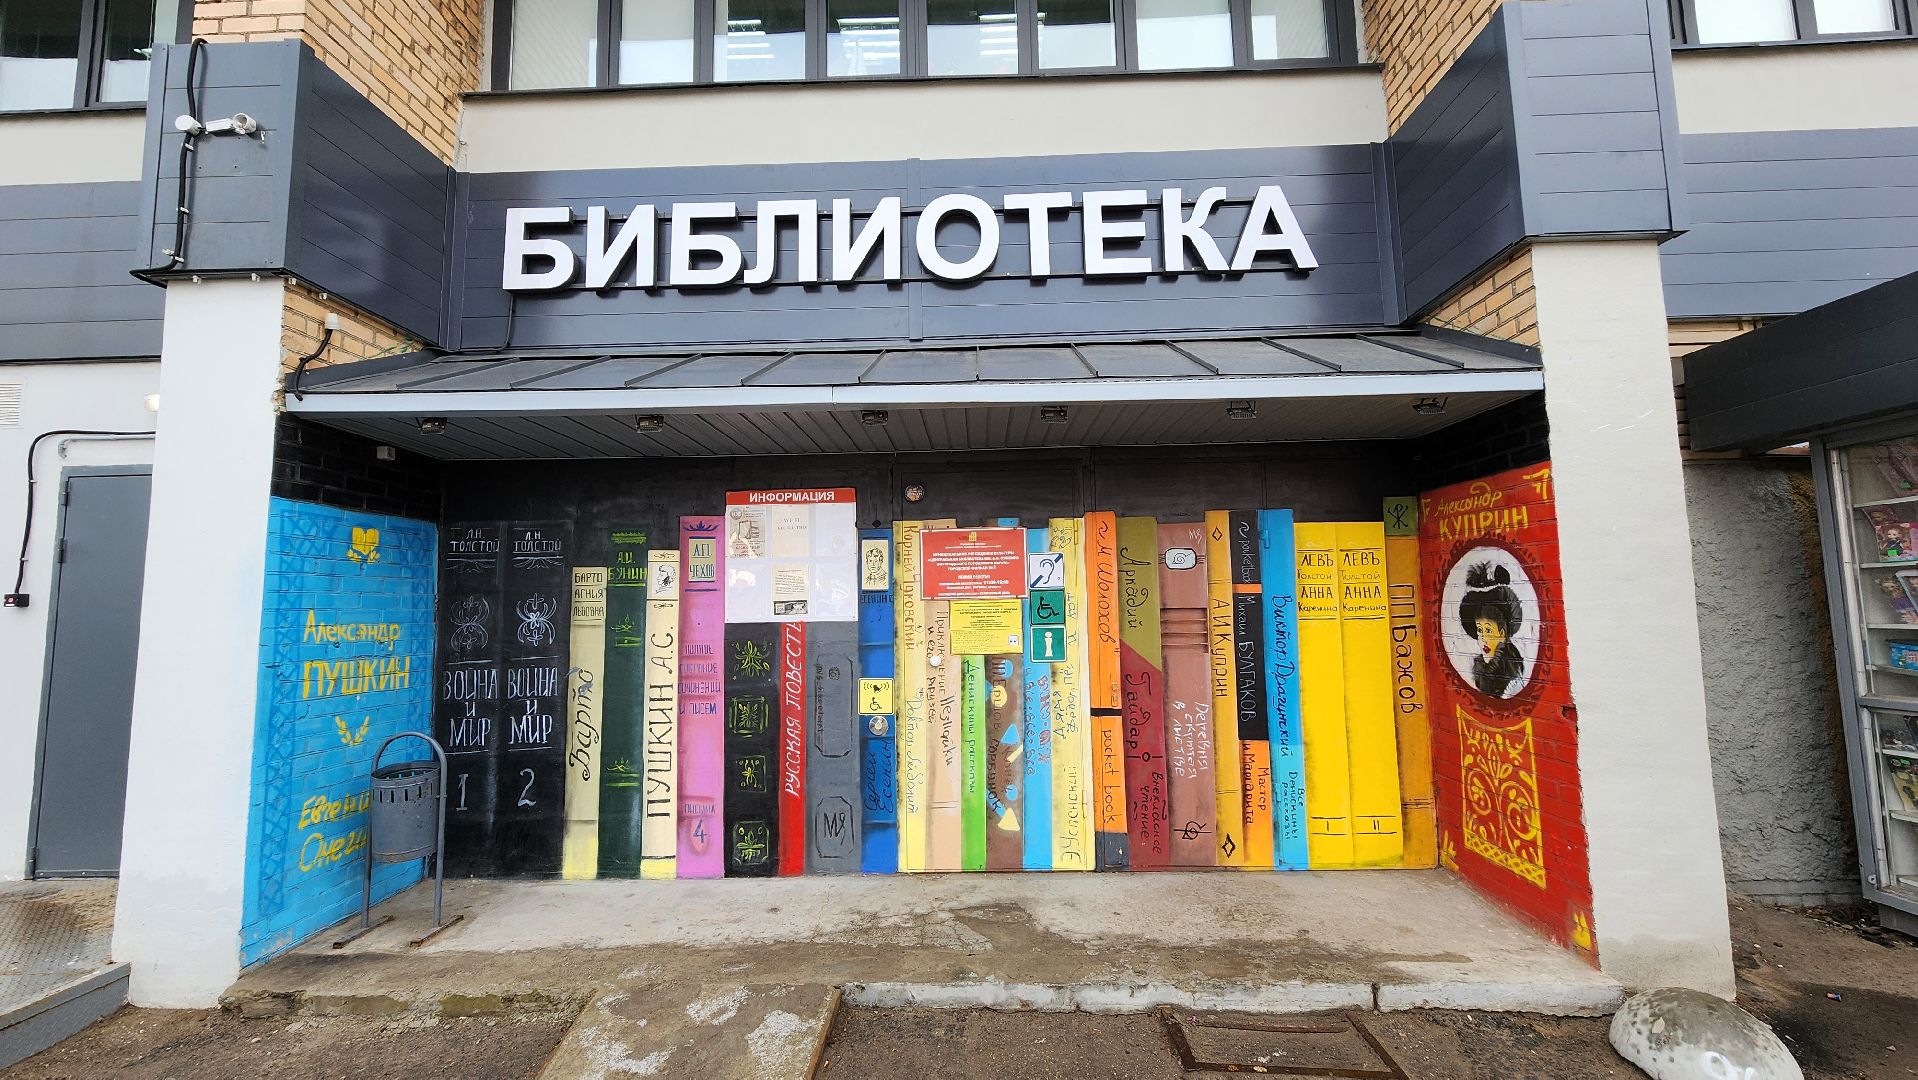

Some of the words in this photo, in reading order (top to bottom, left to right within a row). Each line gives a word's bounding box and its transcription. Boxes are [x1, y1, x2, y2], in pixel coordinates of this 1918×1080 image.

[503, 185, 1318, 290] БИБЛИОТЕКА
[749, 491, 835, 503] ИНФОРМАЦИЯ
[1434, 482, 1502, 516] Александр
[1440, 505, 1528, 540] КУПРИН
[450, 538, 500, 552] ТОЛСТОЙ
[514, 539, 562, 552] ТОЛСТОЙ
[616, 551, 636, 564] А.И.
[1300, 553, 1334, 567] ЛЕВЪ
[1343, 552, 1380, 567] ЛЕВЪ
[574, 572, 603, 583] БАРТО
[607, 567, 647, 581] БУНИН
[690, 564, 715, 578] ЧЕХОВ
[1119, 546, 1152, 628] Аркадий
[1297, 568, 1332, 580] Толстой
[1340, 569, 1381, 580] Толстой
[1098, 563, 1117, 644] Шолохов
[1298, 602, 1338, 613] Каренина
[1300, 585, 1333, 599] АННА
[1342, 602, 1387, 613] Каренина
[1344, 585, 1382, 599] АННА
[572, 606, 605, 617] ЛЬВОВНА
[1238, 594, 1256, 635] Михаил
[1271, 594, 1293, 661] Виктор
[303, 609, 401, 651] Александр
[303, 656, 410, 699] ПУШКИН
[443, 668, 498, 700] ВОЙНА
[508, 665, 558, 699] ВОЙНА
[1238, 640, 1258, 722] БУЛГАКОВ
[1392, 624, 1424, 713] Бажов
[568, 668, 600, 783] Барто
[1125, 671, 1152, 750] Гайдар
[449, 717, 491, 747] МИР
[508, 714, 553, 745] МИР
[647, 685, 673, 819] ПУШКИН
[784, 718, 800, 799] РУССКАЯ
[1101, 729, 1119, 775] pocket
[456, 773, 469, 811] 1
[517, 768, 537, 807] 2
[876, 740, 894, 814] Есенин
[1243, 754, 1256, 825] Маргарита
[1258, 767, 1270, 811] Мастер
[1103, 785, 1121, 824] book
[1140, 786, 1153, 838] чтение
[692, 820, 707, 844] 4
